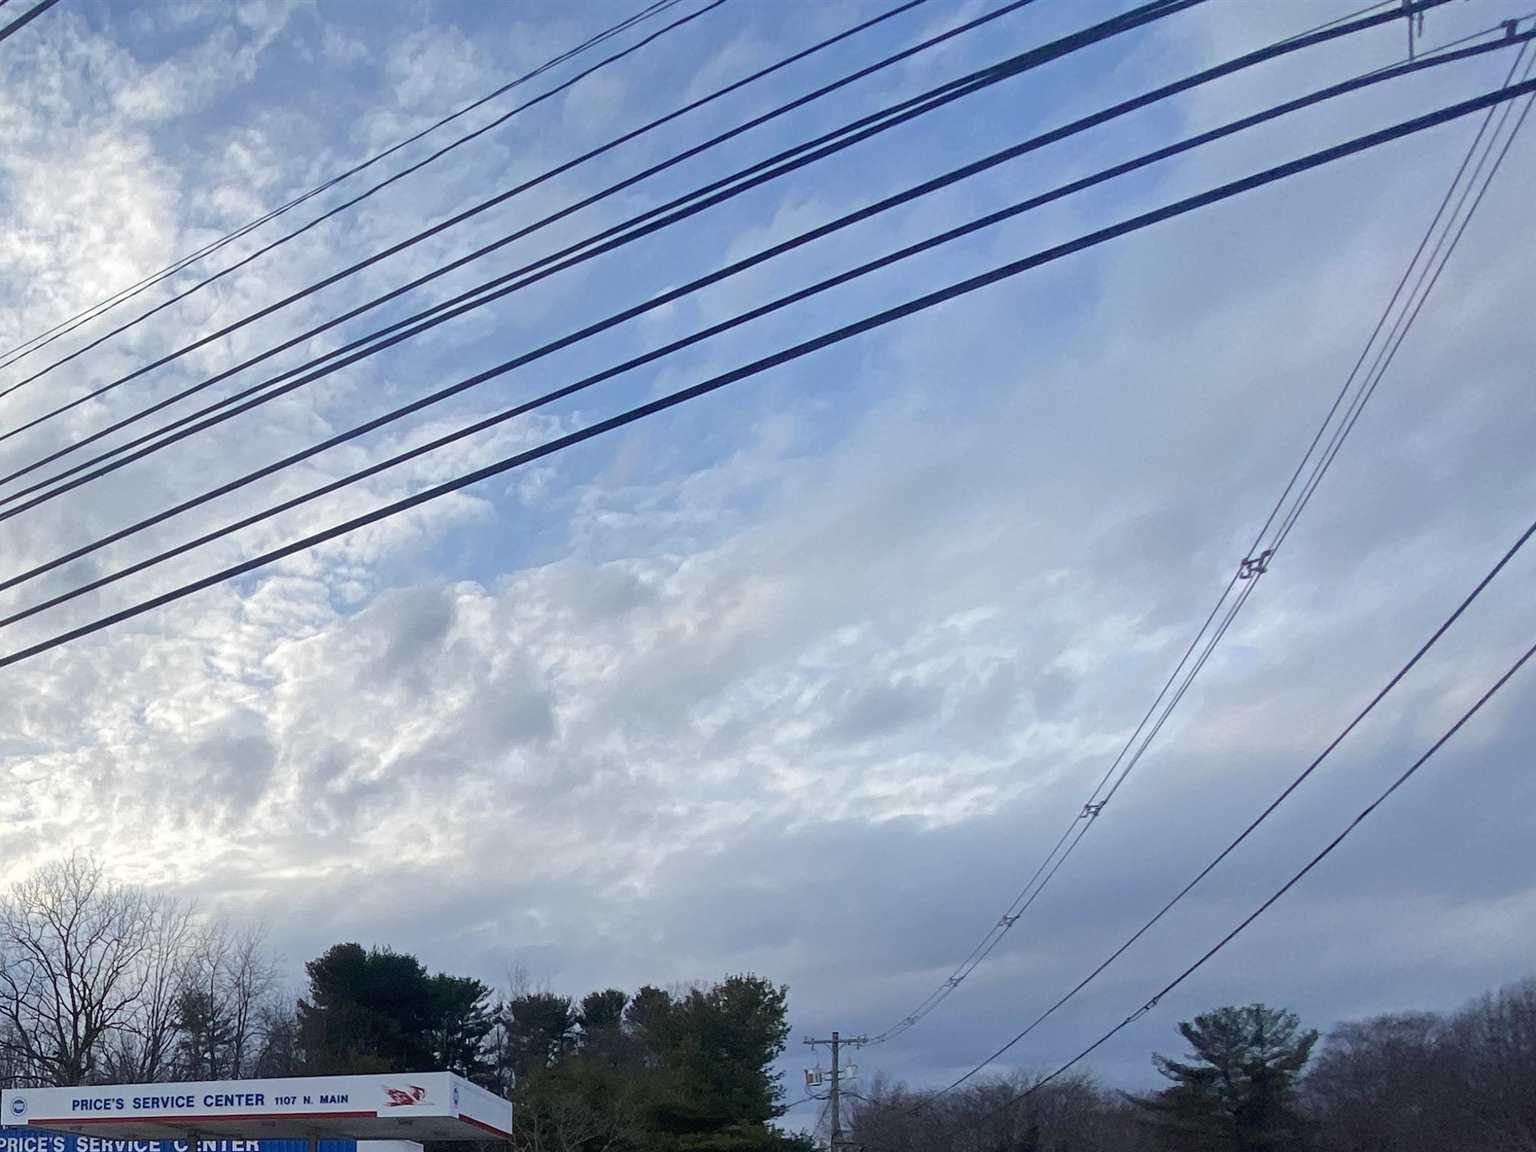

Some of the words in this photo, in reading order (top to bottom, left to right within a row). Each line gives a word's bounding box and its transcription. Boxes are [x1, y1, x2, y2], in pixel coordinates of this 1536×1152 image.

[72, 1097, 124, 1111] PRICE'S
[132, 1096, 194, 1109] SERVICE
[203, 1093, 265, 1108] CENTER
[274, 1096, 297, 1106] 1107
[319, 1094, 349, 1105] MAIN
[76, 1136, 161, 1152] SERVICE
[173, 1140, 260, 1152] CNTER
